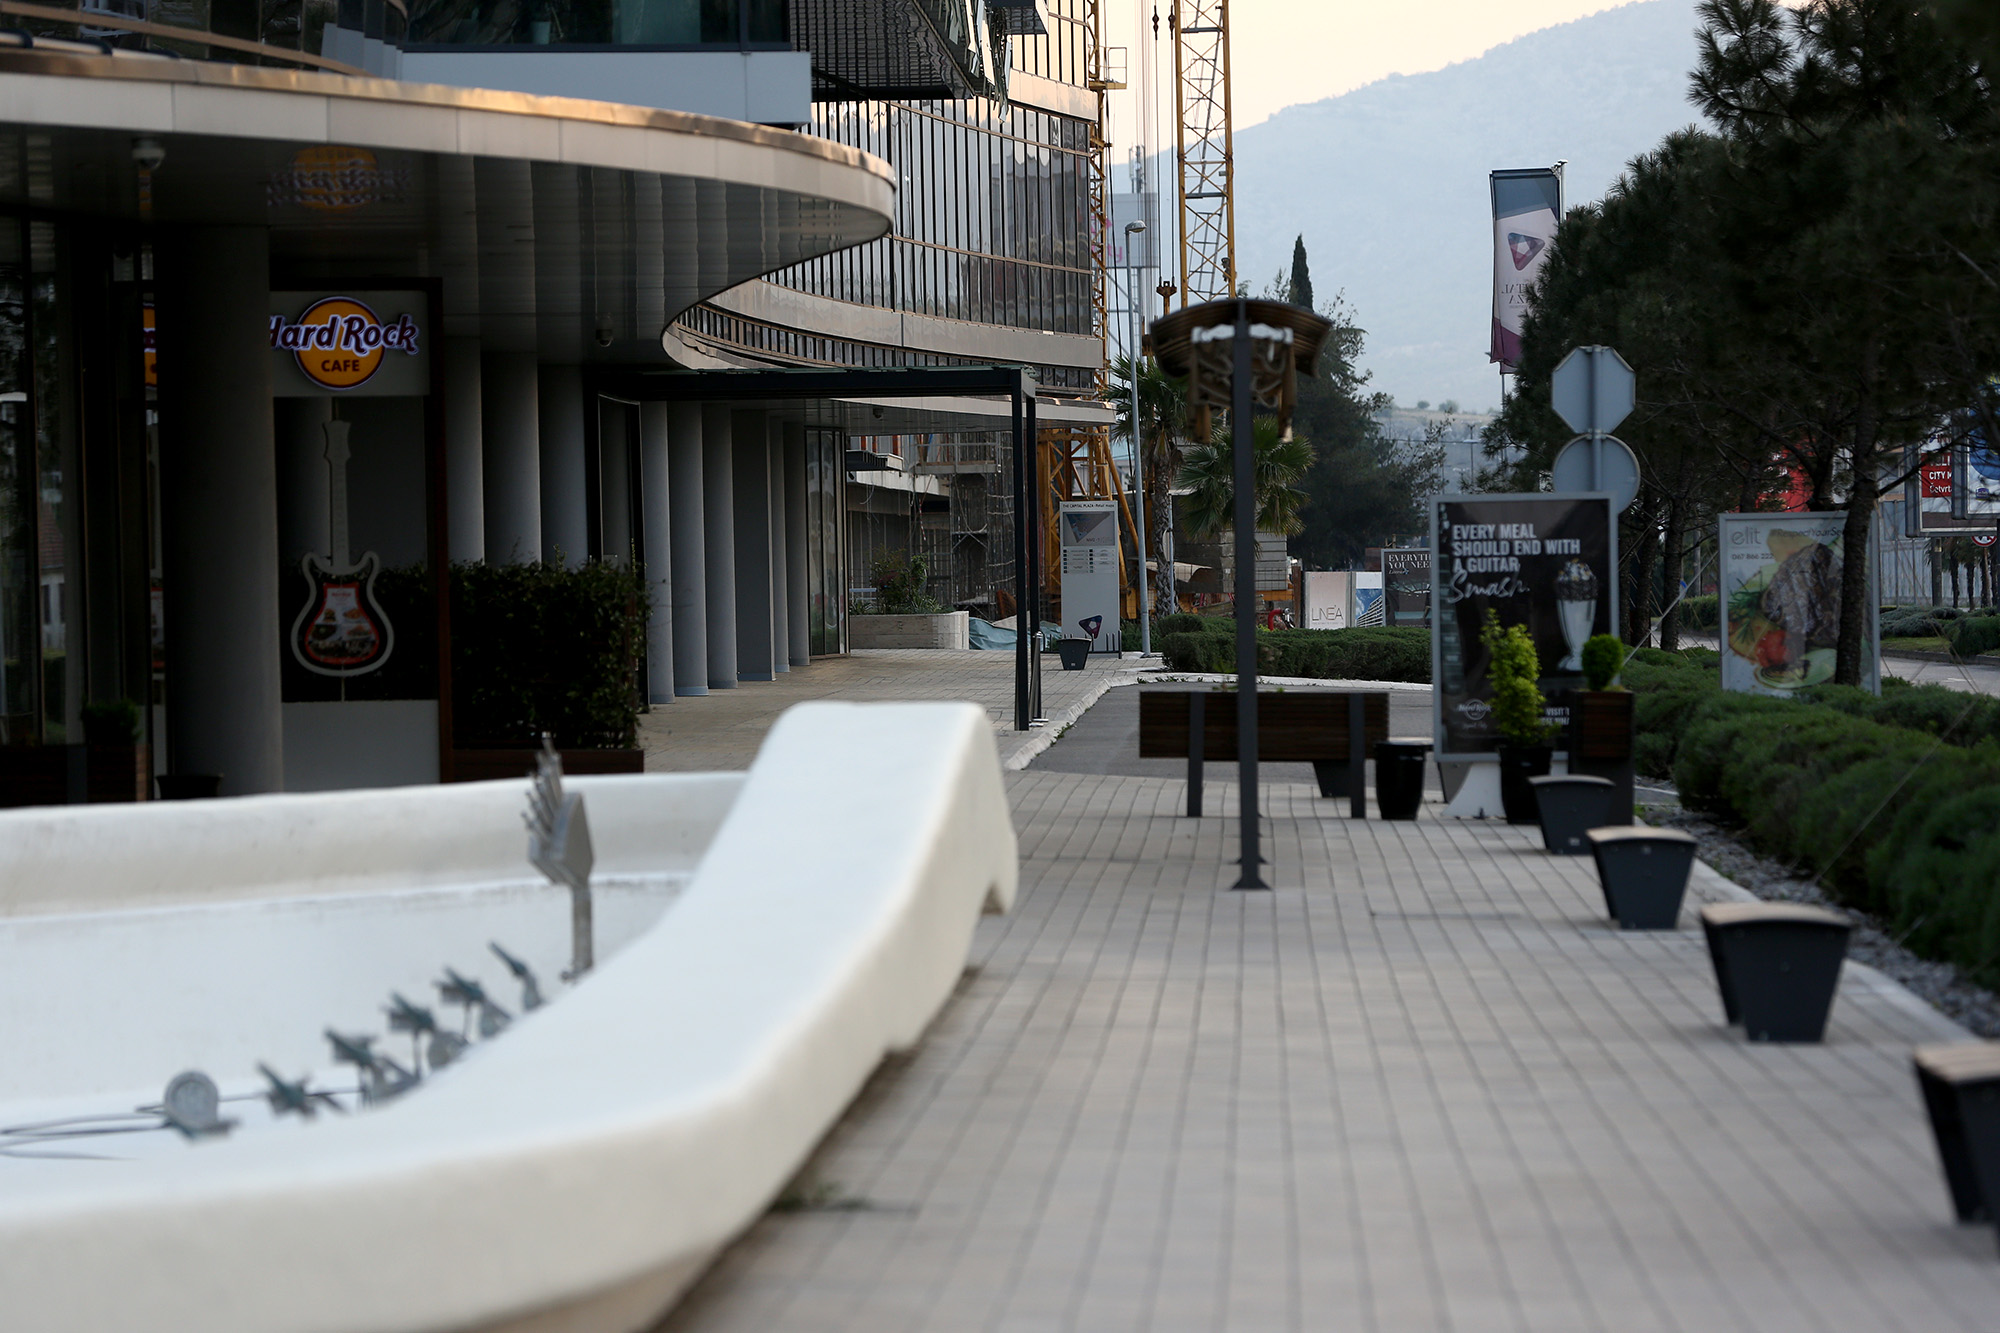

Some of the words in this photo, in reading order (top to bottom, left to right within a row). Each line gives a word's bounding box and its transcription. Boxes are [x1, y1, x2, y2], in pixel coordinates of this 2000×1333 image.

[341, 313, 420, 358] Rock
[321, 360, 360, 372] CAFE
[1929, 471, 1946, 481] CITY
[1929, 482, 1953, 494] Četvrt
[1452, 523, 1496, 540] EVERY
[1499, 523, 1537, 540] MEAL
[1731, 526, 1761, 545] elit
[1452, 540, 1510, 556] SHOULD
[1513, 539, 1542, 555] END
[1543, 538, 1581, 555] WITH
[1452, 557, 1463, 573] A
[1466, 556, 1519, 573] GUITAR
[1546, 706, 1564, 716] VISIT
